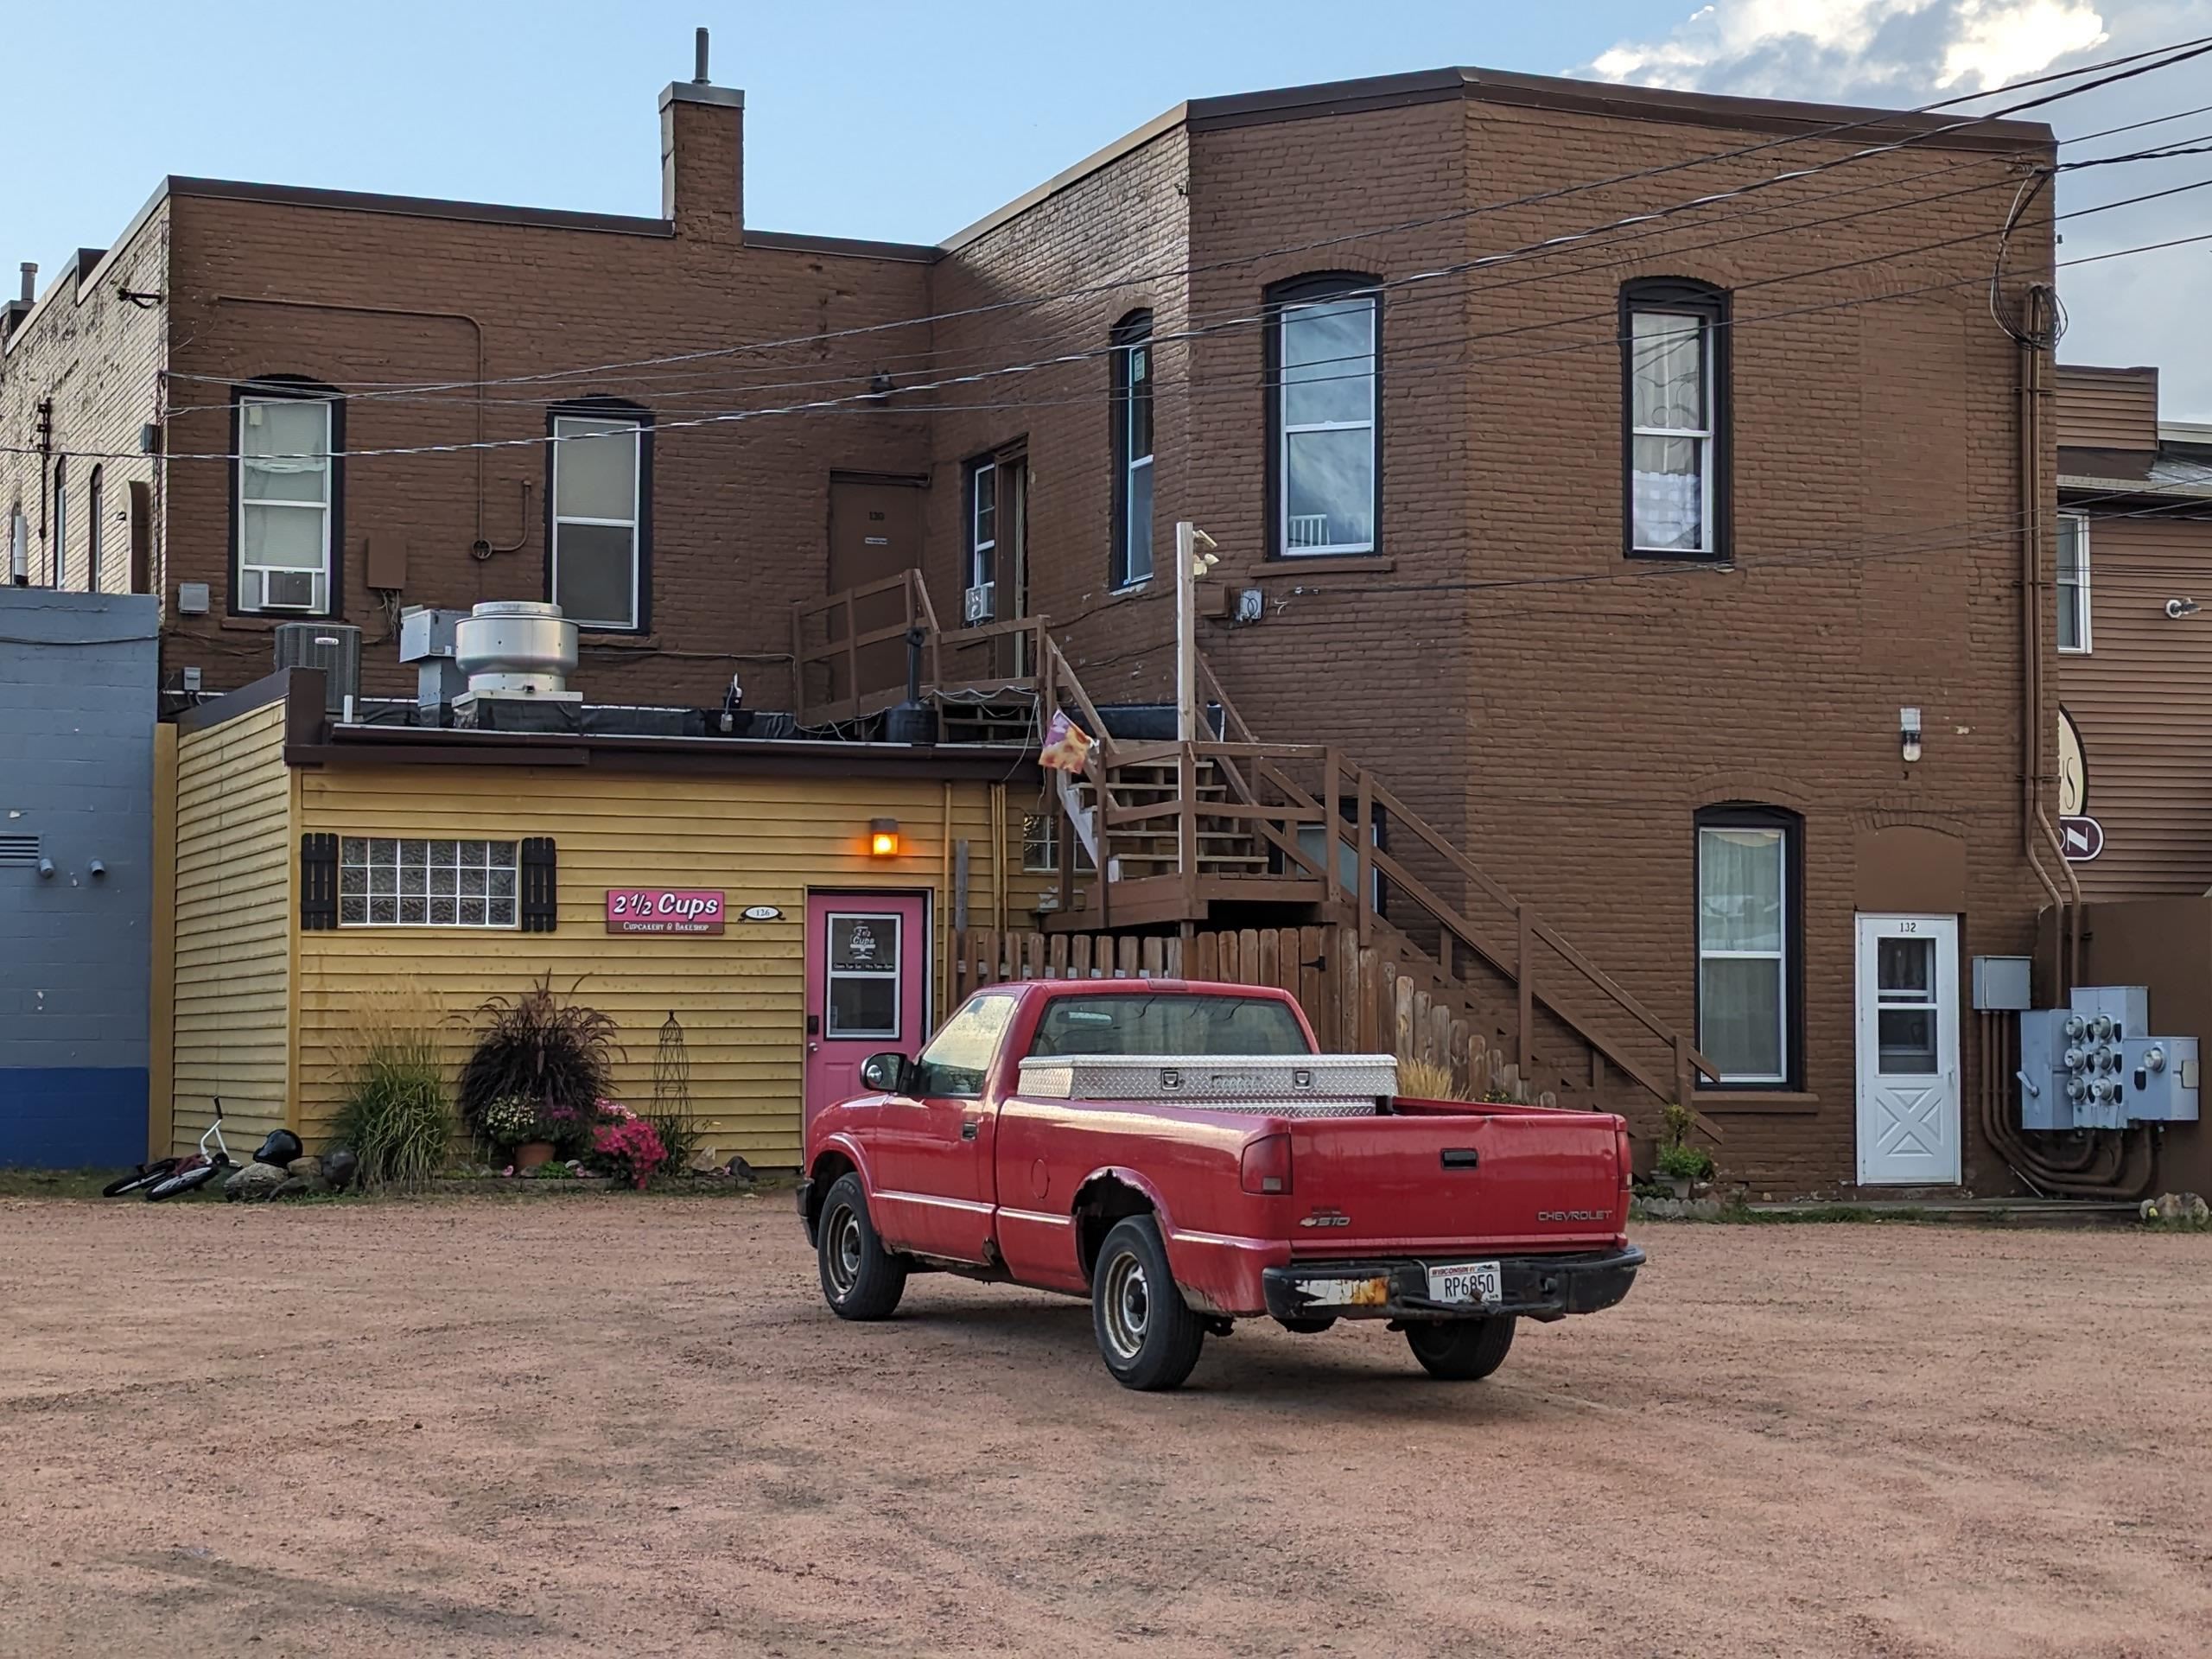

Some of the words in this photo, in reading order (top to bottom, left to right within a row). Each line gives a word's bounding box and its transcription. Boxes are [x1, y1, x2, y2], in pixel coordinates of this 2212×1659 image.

[613, 895, 627, 914] 2
[658, 893, 718, 920] Cups
[667, 922, 673, 931] &
[1900, 922, 1916, 933] 132
[1538, 1211, 1613, 1221] CHEVROLET
[1317, 1217, 1351, 1226] S10
[1444, 1274, 1495, 1299] RP6850
